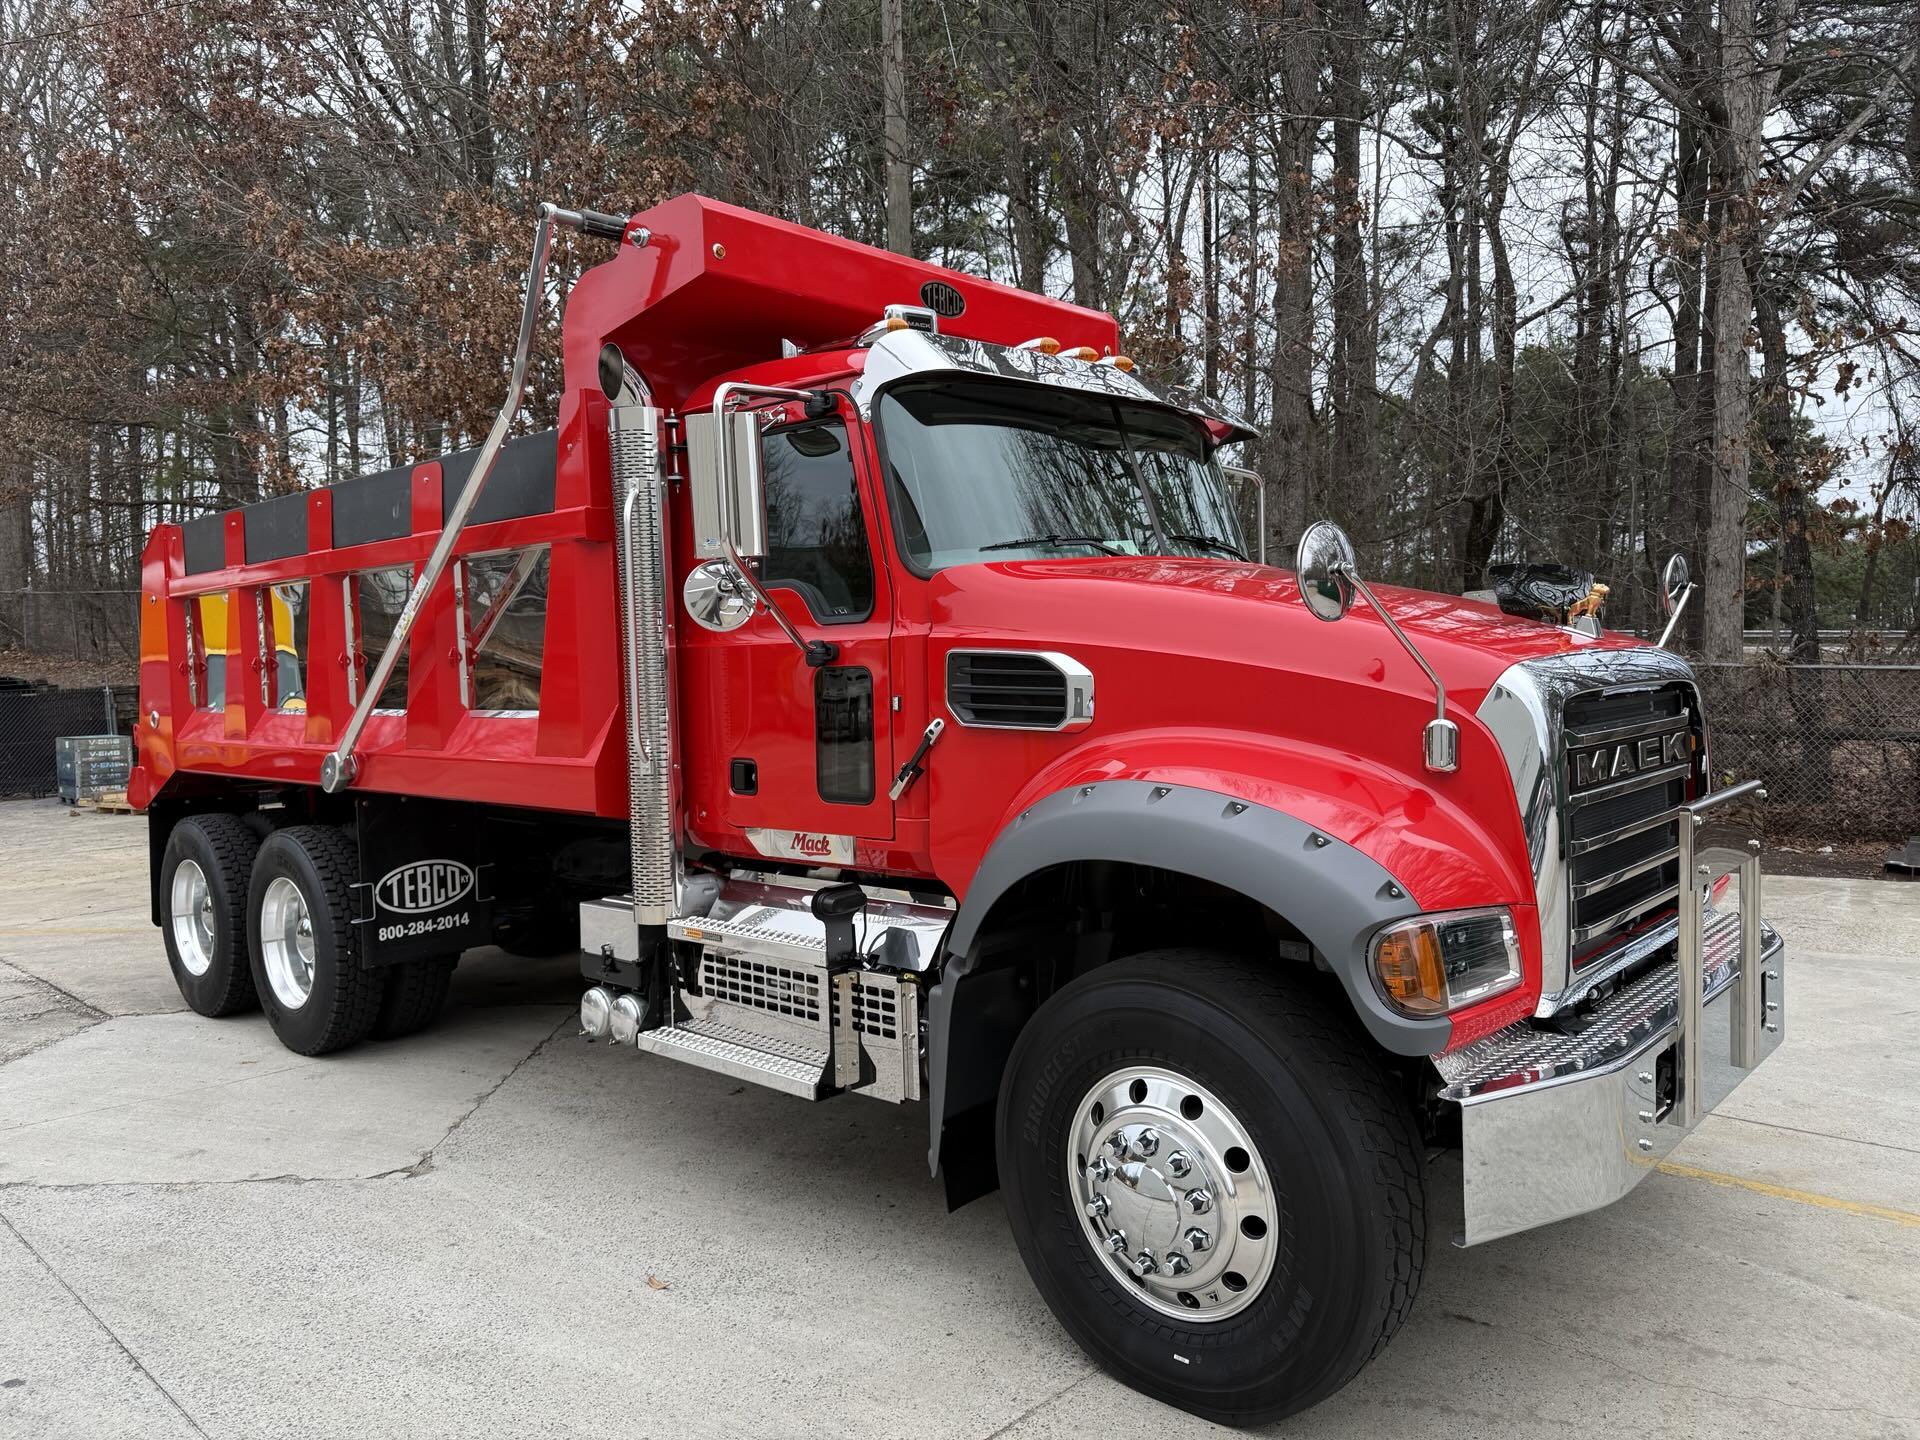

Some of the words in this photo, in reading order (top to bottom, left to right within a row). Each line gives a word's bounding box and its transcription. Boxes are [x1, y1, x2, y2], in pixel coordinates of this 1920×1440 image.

[924, 283, 961, 315] TEBCO
[908, 321, 931, 330] MACK
[1576, 731, 1687, 786] MACK
[790, 833, 832, 856] Mack
[386, 864, 461, 908] TEBCO
[378, 911, 470, 941] 800-284-2014
